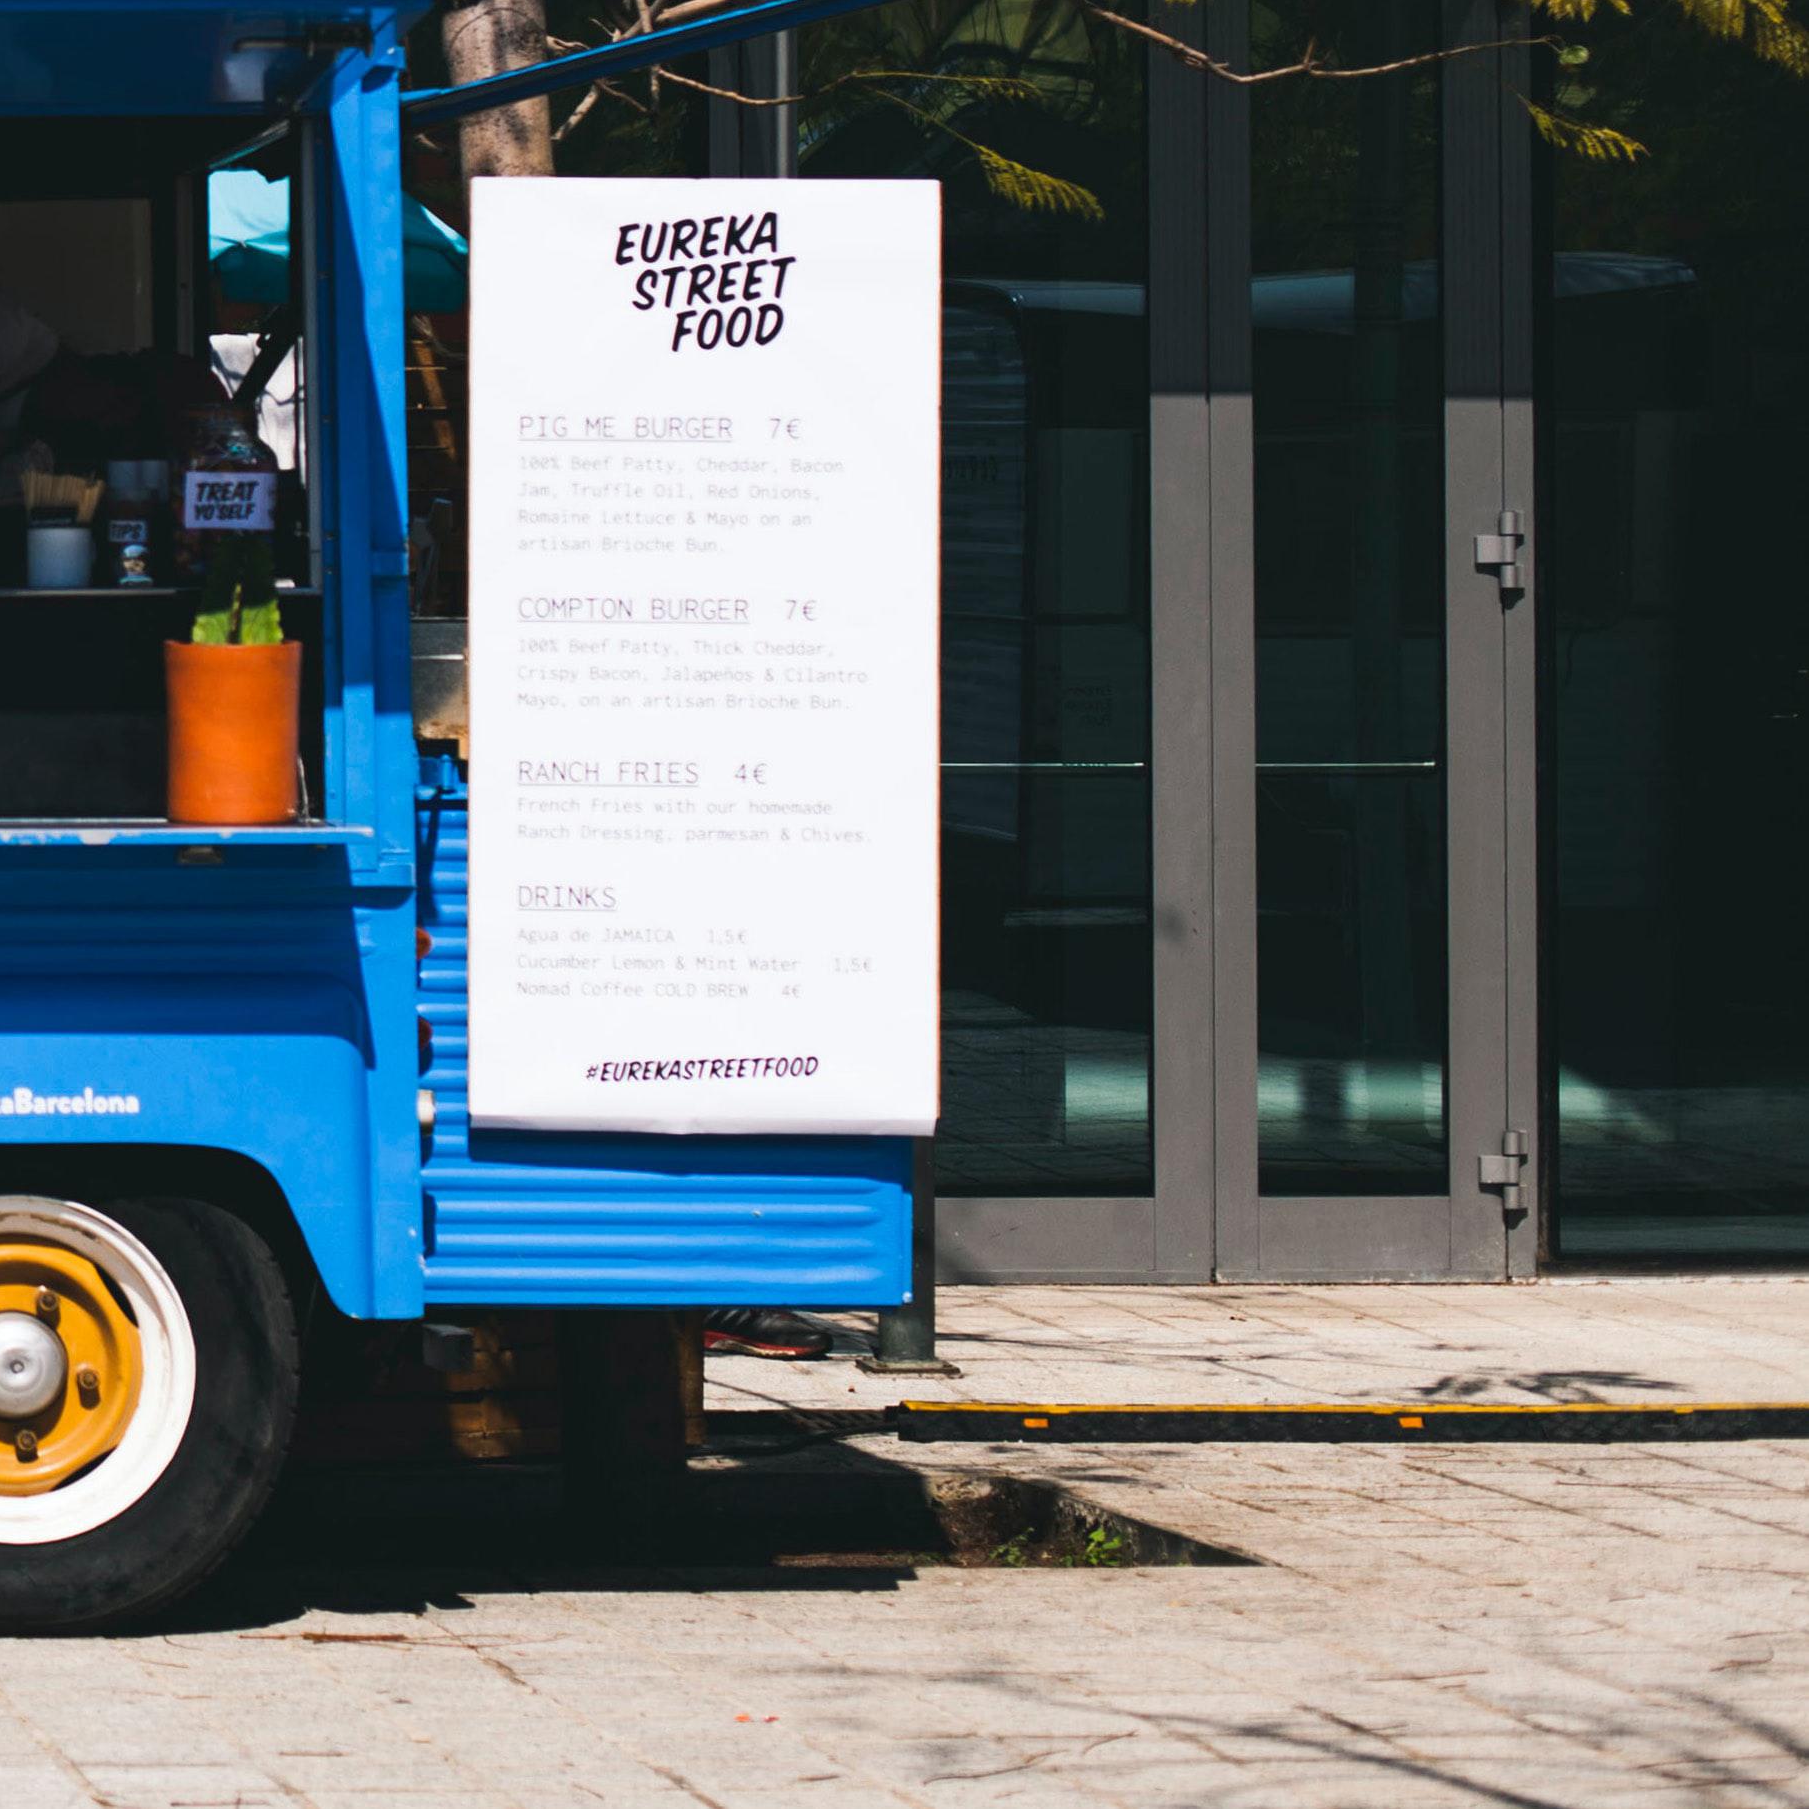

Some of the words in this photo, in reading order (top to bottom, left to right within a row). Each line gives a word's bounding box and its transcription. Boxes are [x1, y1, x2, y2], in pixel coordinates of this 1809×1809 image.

[615, 212, 779, 266] EUREKA
[631, 256, 797, 311] STREET
[671, 302, 784, 353] FOOD
[518, 415, 568, 439] PIG
[585, 416, 616, 439] ME
[635, 417, 733, 439] BURGER
[769, 417, 803, 440] 7€
[518, 455, 559, 470] 100%
[570, 456, 613, 471] Beef
[790, 458, 845, 473] Bacon
[196, 481, 259, 502] TREAT
[570, 483, 644, 499] Truffle
[706, 484, 739, 499] Red
[518, 510, 591, 525] Romaine
[602, 510, 676, 525] Lettuce
[685, 511, 697, 525] &
[706, 511, 749, 528] Mayo
[759, 513, 781, 527] on
[791, 513, 812, 527] an
[518, 537, 591, 551] artisan
[602, 537, 674, 552] Brioche
[518, 597, 633, 620] COMPTON
[651, 598, 749, 621] BURGER
[785, 599, 819, 621] 7€
[518, 639, 558, 653] 100%
[569, 639, 608, 655] Beef
[693, 640, 744, 656] Thick
[517, 665, 579, 684] Crispy
[764, 668, 775, 682] &
[785, 668, 868, 684] Cilantro
[579, 696, 600, 707] on
[611, 696, 632, 708] an
[642, 695, 715, 709] artisan
[725, 696, 800, 710] Brioche
[518, 761, 600, 784] RANCH
[618, 761, 699, 785] FRIES
[734, 762, 769, 785] 4€
[517, 798, 581, 813] French
[591, 798, 643, 814] Fries
[654, 799, 696, 814] with
[706, 802, 737, 815] our
[749, 800, 832, 815] homemade
[517, 824, 570, 839] Ranch
[685, 828, 769, 843] parmesan
[780, 827, 791, 841] &
[518, 886, 617, 909] DRINKS
[517, 928, 559, 946] Agua
[570, 928, 591, 943] de
[601, 929, 675, 944] JAMAICA
[516, 956, 600, 970] Cucumber
[612, 957, 665, 971] Lemon
[675, 957, 686, 971] &
[695, 957, 737, 972] Mint
[748, 958, 801, 972] Water
[516, 982, 570, 996] Nomad
[581, 983, 643, 998] Coffee
[654, 983, 696, 998] COLD
[706, 984, 749, 998] BREW
[585, 1055, 820, 1083] #EUREKASTREETFOOD
